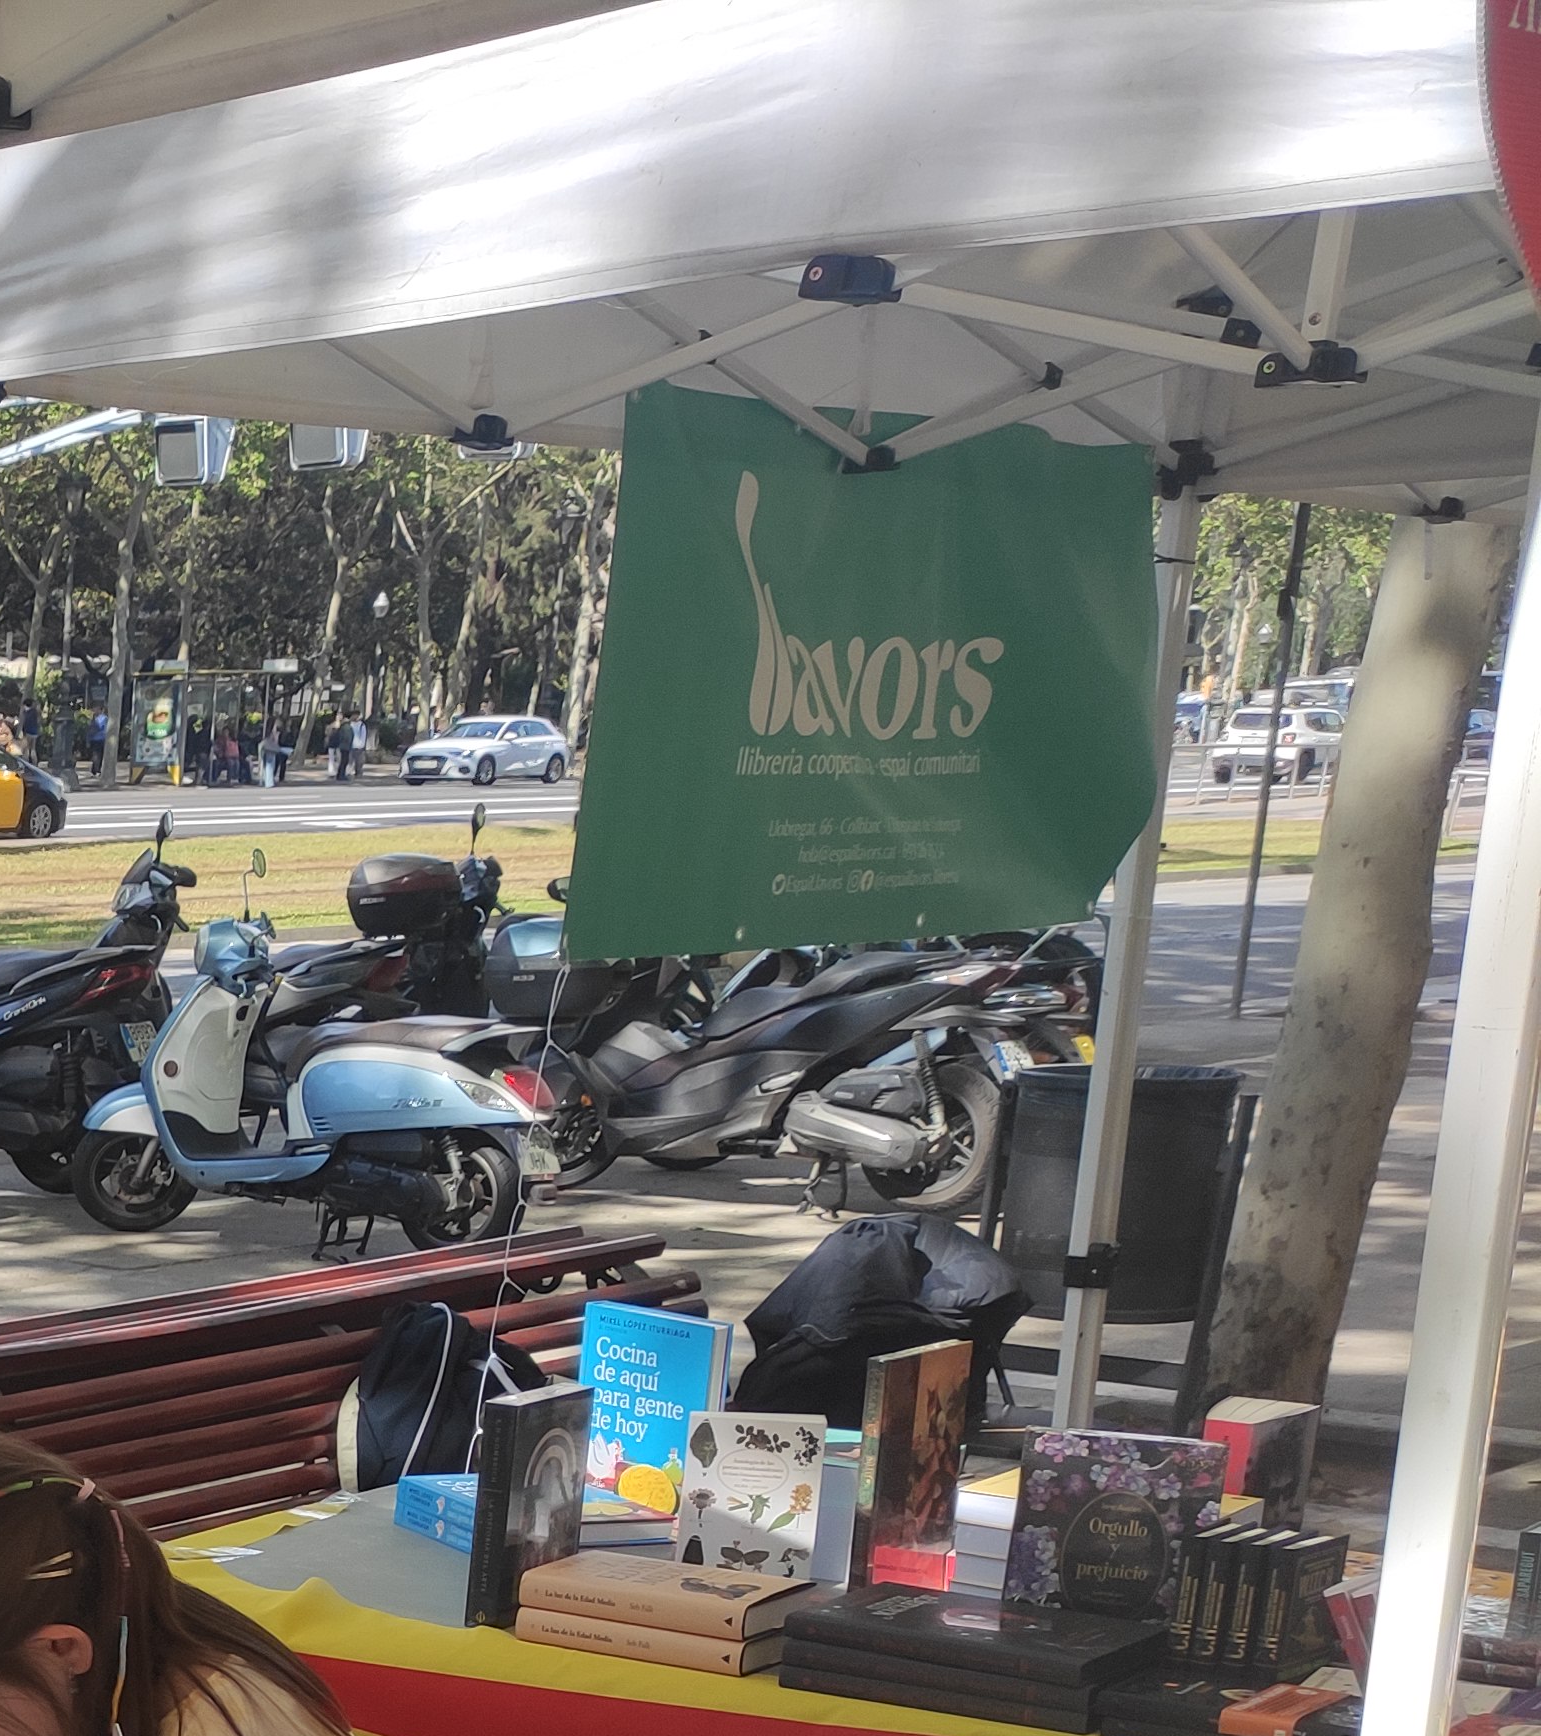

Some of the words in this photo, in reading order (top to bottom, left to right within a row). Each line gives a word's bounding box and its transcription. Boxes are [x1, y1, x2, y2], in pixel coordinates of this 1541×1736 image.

[736, 746, 803, 776] llibreria
[596, 1336, 658, 1368] Cocina
[594, 1360, 616, 1382] de
[620, 1369, 660, 1392] aquí
[635, 1396, 684, 1421] gente
[615, 1412, 648, 1443] hoy
[1089, 1517, 1148, 1540] Orgullo
[1076, 1562, 1148, 1582] prejuicio
